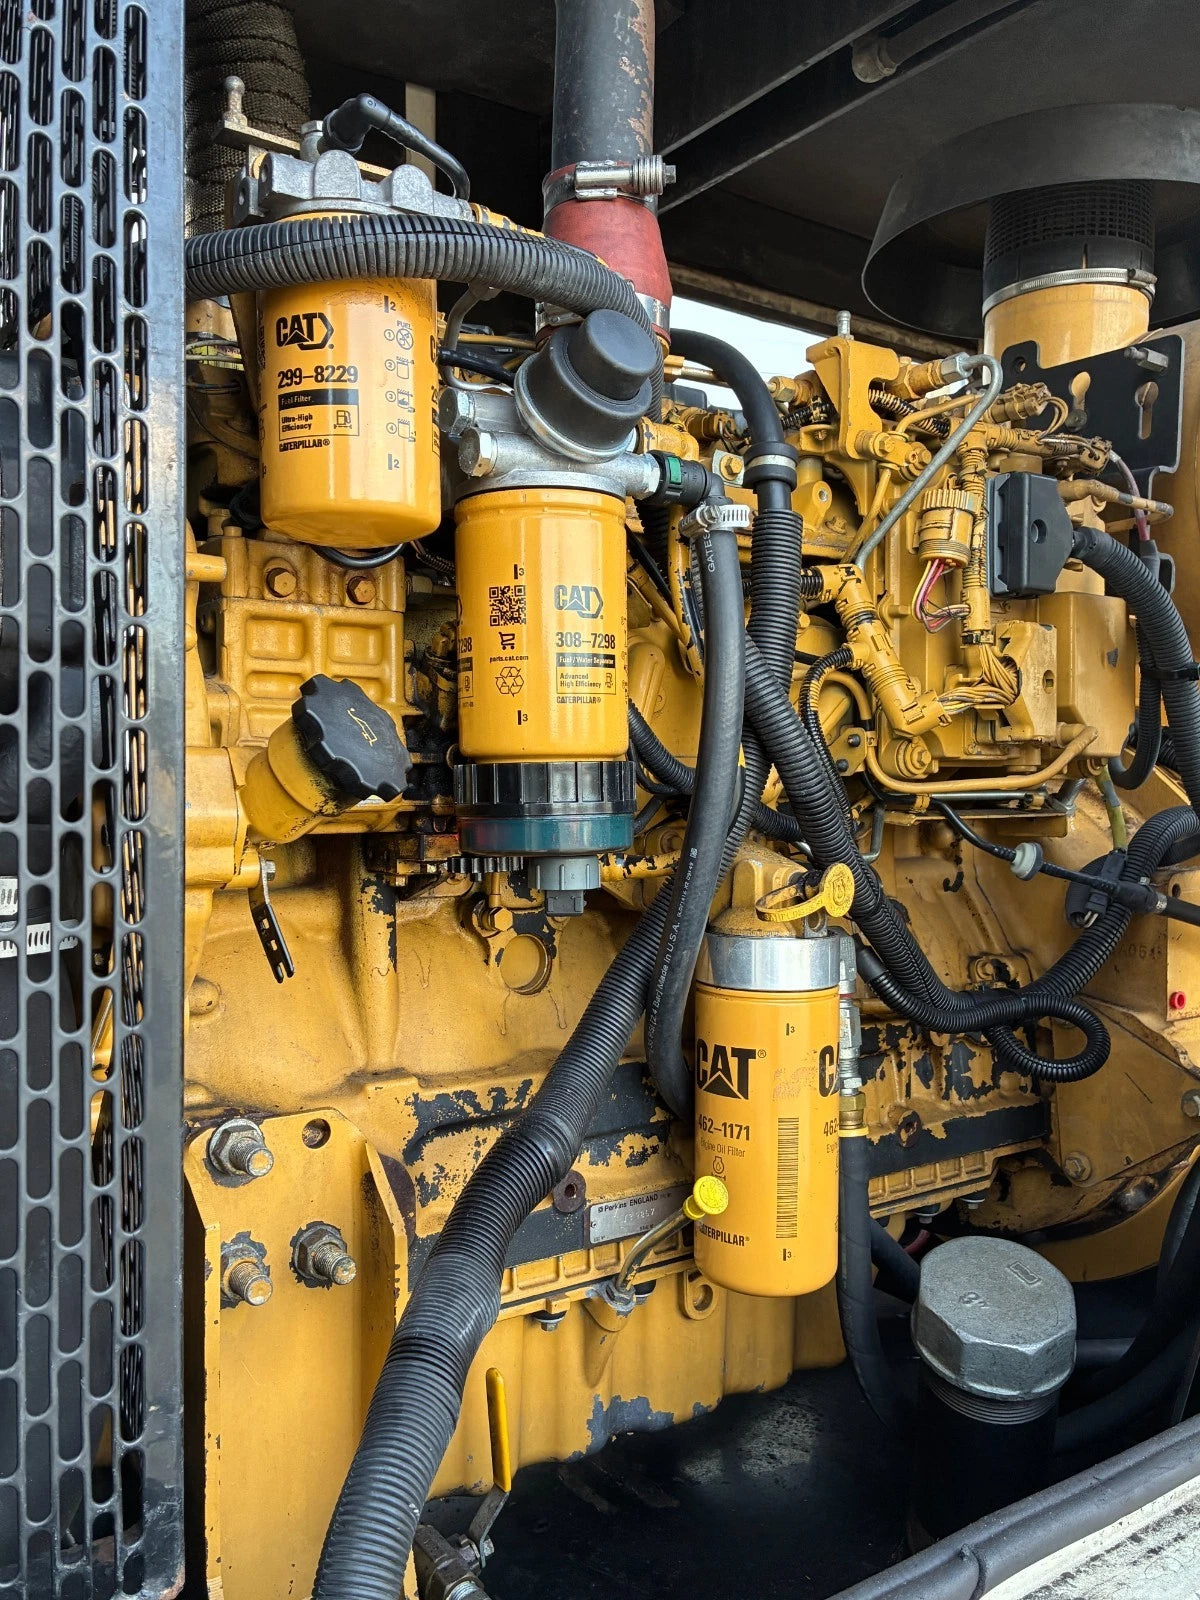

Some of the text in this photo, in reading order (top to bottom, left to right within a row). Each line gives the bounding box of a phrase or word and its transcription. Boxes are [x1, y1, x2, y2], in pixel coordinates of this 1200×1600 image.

[276, 312, 320, 348] CAT
[397, 320, 412, 330] FUEL
[278, 365, 358, 389] 299-8229
[294, 394, 312, 403] Filter
[282, 413, 313, 424] Ultra-High
[282, 422, 312, 433] Efficiency
[554, 585, 594, 612] CAT
[556, 632, 616, 650] 308-7298
[489, 655, 529, 664] parts.cat.com
[560, 673, 589, 681] Advanced
[560, 680, 601, 689] High Efficiency
[657, 965, 668, 989] Made
[717, 1144, 726, 1154] Oil
[728, 1145, 746, 1157] Filter
[604, 1203, 627, 1214] Perkins
[629, 1194, 659, 1207] ENGLAND
